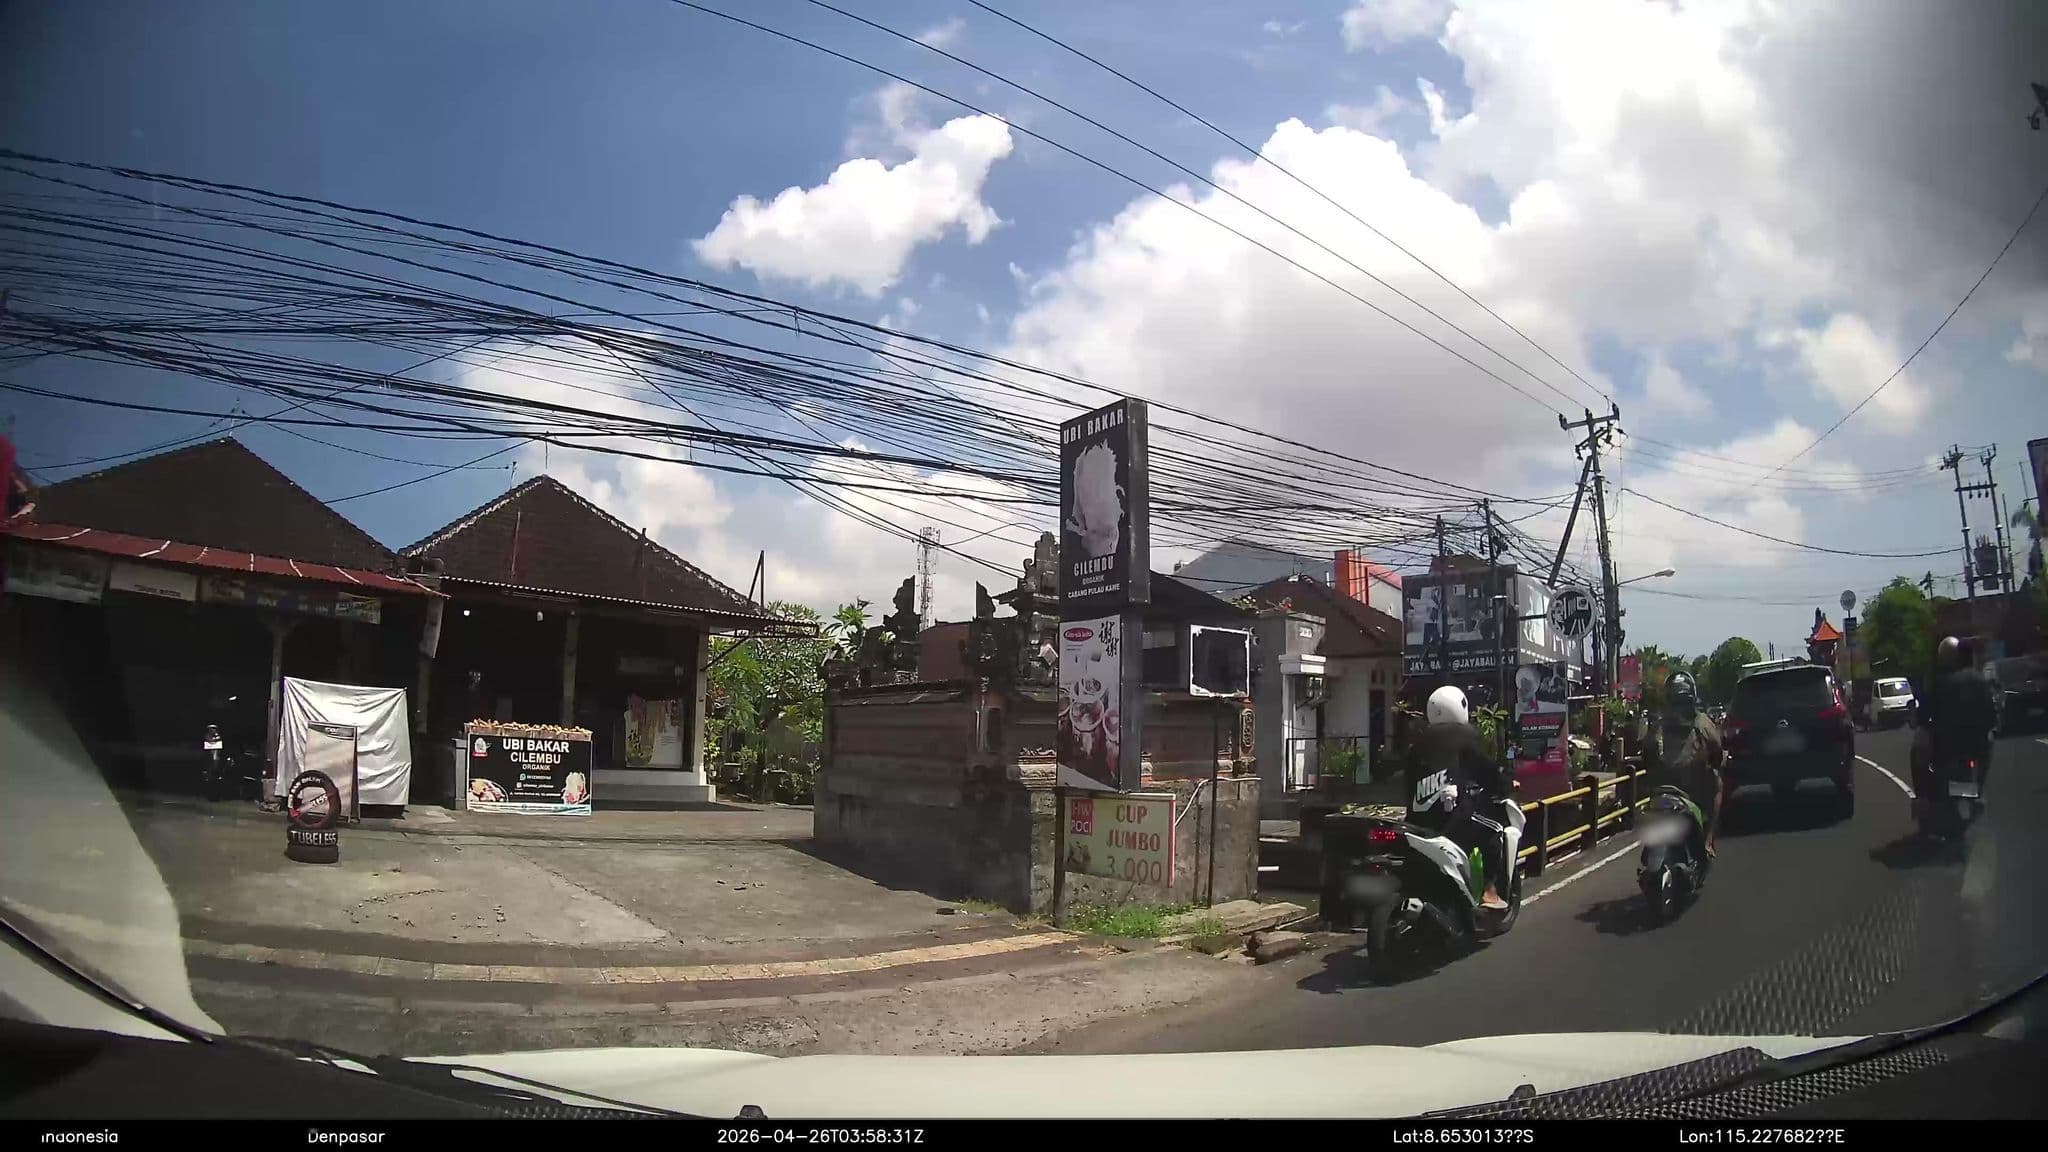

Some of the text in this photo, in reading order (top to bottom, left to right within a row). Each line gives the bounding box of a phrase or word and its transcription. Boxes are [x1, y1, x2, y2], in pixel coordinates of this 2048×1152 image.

[1063, 408, 1124, 445] UBI BAKAR
[1073, 555, 1114, 577] CILEMBU
[502, 738, 570, 753] UBI BAKAR
[510, 751, 561, 764] CILEMBU
[522, 763, 551, 771] ORGANIK
[1416, 767, 1449, 802] NIKE
[1116, 804, 1148, 825] CUP
[289, 830, 337, 846] TUBELESS
[1106, 828, 1160, 852] JUMBO
